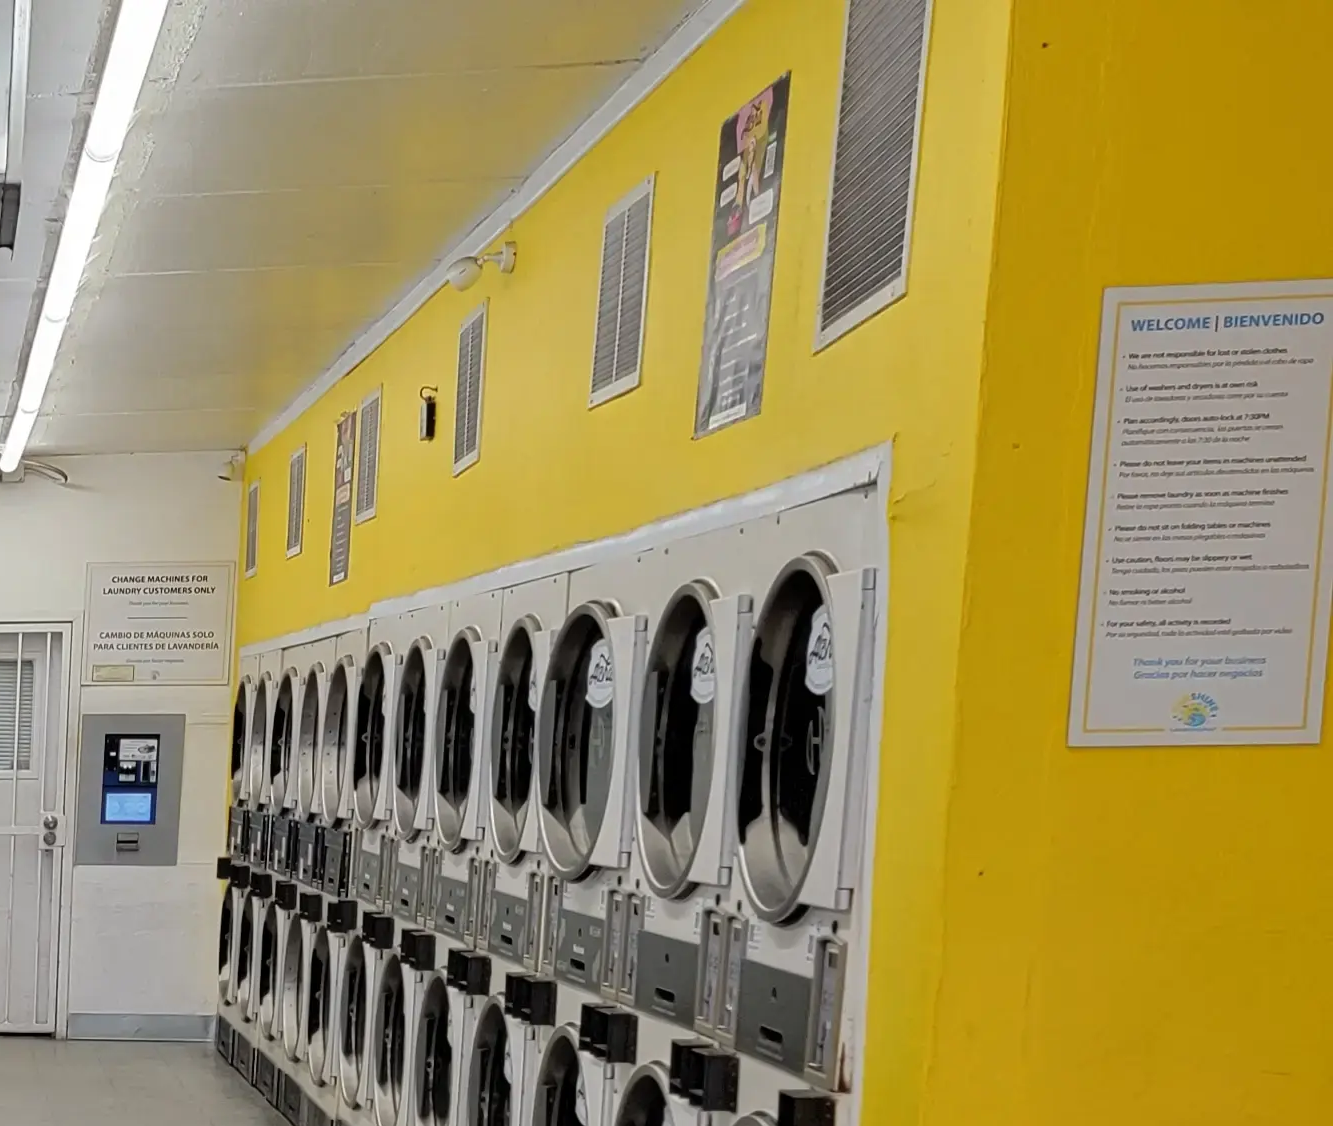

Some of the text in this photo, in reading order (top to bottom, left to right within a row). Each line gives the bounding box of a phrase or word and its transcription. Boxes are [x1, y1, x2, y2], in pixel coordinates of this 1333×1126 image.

[1131, 312, 1324, 332] WELCOME BIENVENIDO
[1166, 351, 1206, 359] responsible
[1192, 383, 1213, 391] dryers
[1266, 455, 1307, 463] unattended
[1167, 491, 1194, 499] laundry
[1262, 488, 1288, 496] finishes
[1182, 523, 1205, 531] folding
[1238, 521, 1271, 529] machines
[1202, 554, 1229, 563] slippery
[147, 575, 190, 583] MACHINES
[192, 575, 208, 583] FOR
[143, 587, 193, 595] CUSTOMERS
[1119, 621, 1134, 629] your
[1168, 618, 1191, 627] activity
[146, 630, 191, 639] MÁQUINAS
[168, 642, 219, 650] LAVANDERÍA
[1133, 656, 1266, 668] Thank you for your business
[1134, 669, 1263, 680] Gracias por hacer negocios
